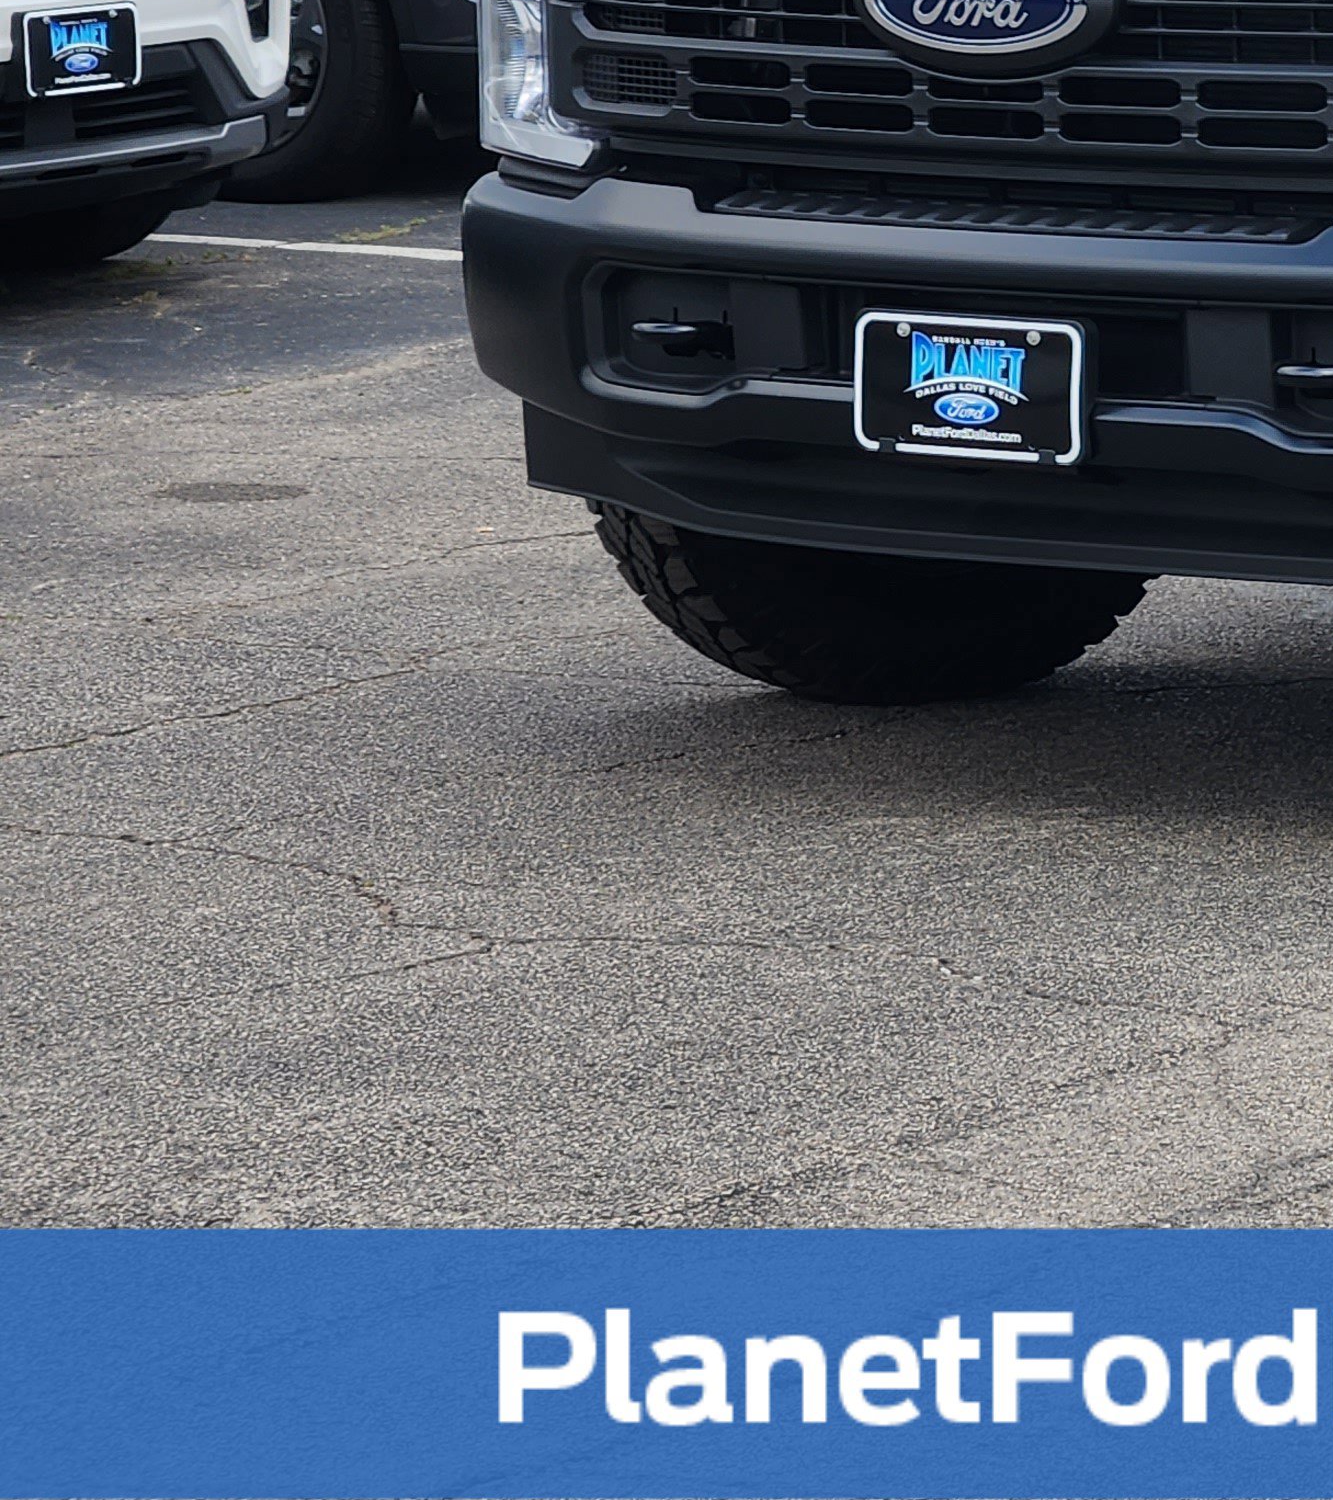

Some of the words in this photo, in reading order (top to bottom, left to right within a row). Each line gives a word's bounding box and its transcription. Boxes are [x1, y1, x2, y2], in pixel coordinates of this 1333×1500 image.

[50, 20, 109, 58] PLANET
[911, 331, 1026, 394] PLANET
[914, 382, 957, 399] DALLAS
[958, 382, 987, 394] LOVE
[988, 386, 1020, 406] FIELD
